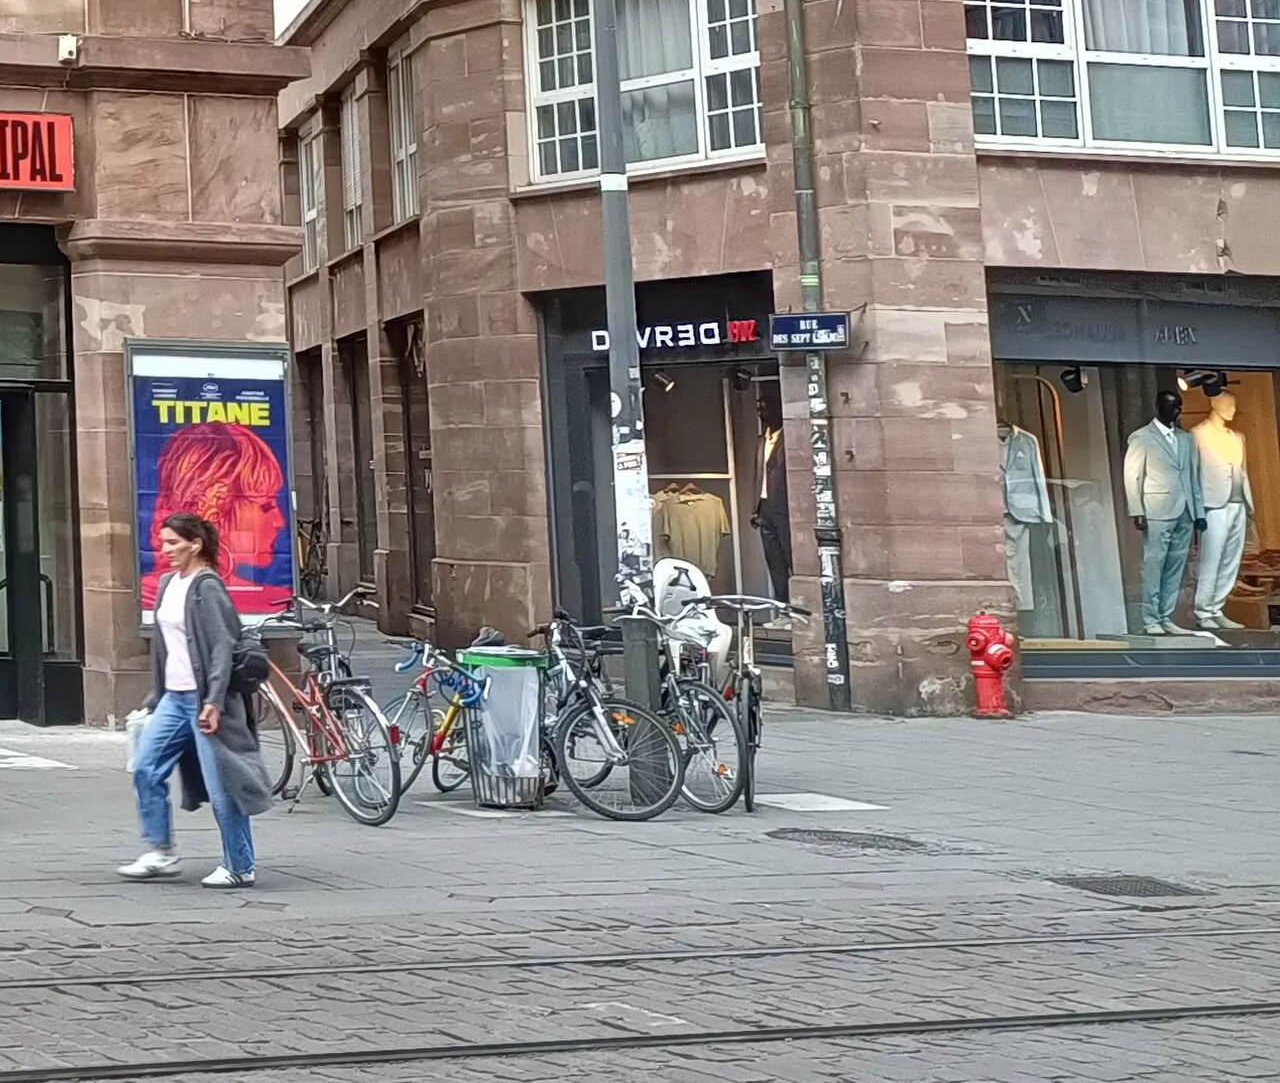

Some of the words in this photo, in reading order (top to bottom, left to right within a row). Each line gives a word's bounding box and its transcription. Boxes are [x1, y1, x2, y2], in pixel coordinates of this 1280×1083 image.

[799, 319, 818, 330] RUE
[790, 333, 811, 344] SEPT
[151, 399, 271, 426] TITANE
